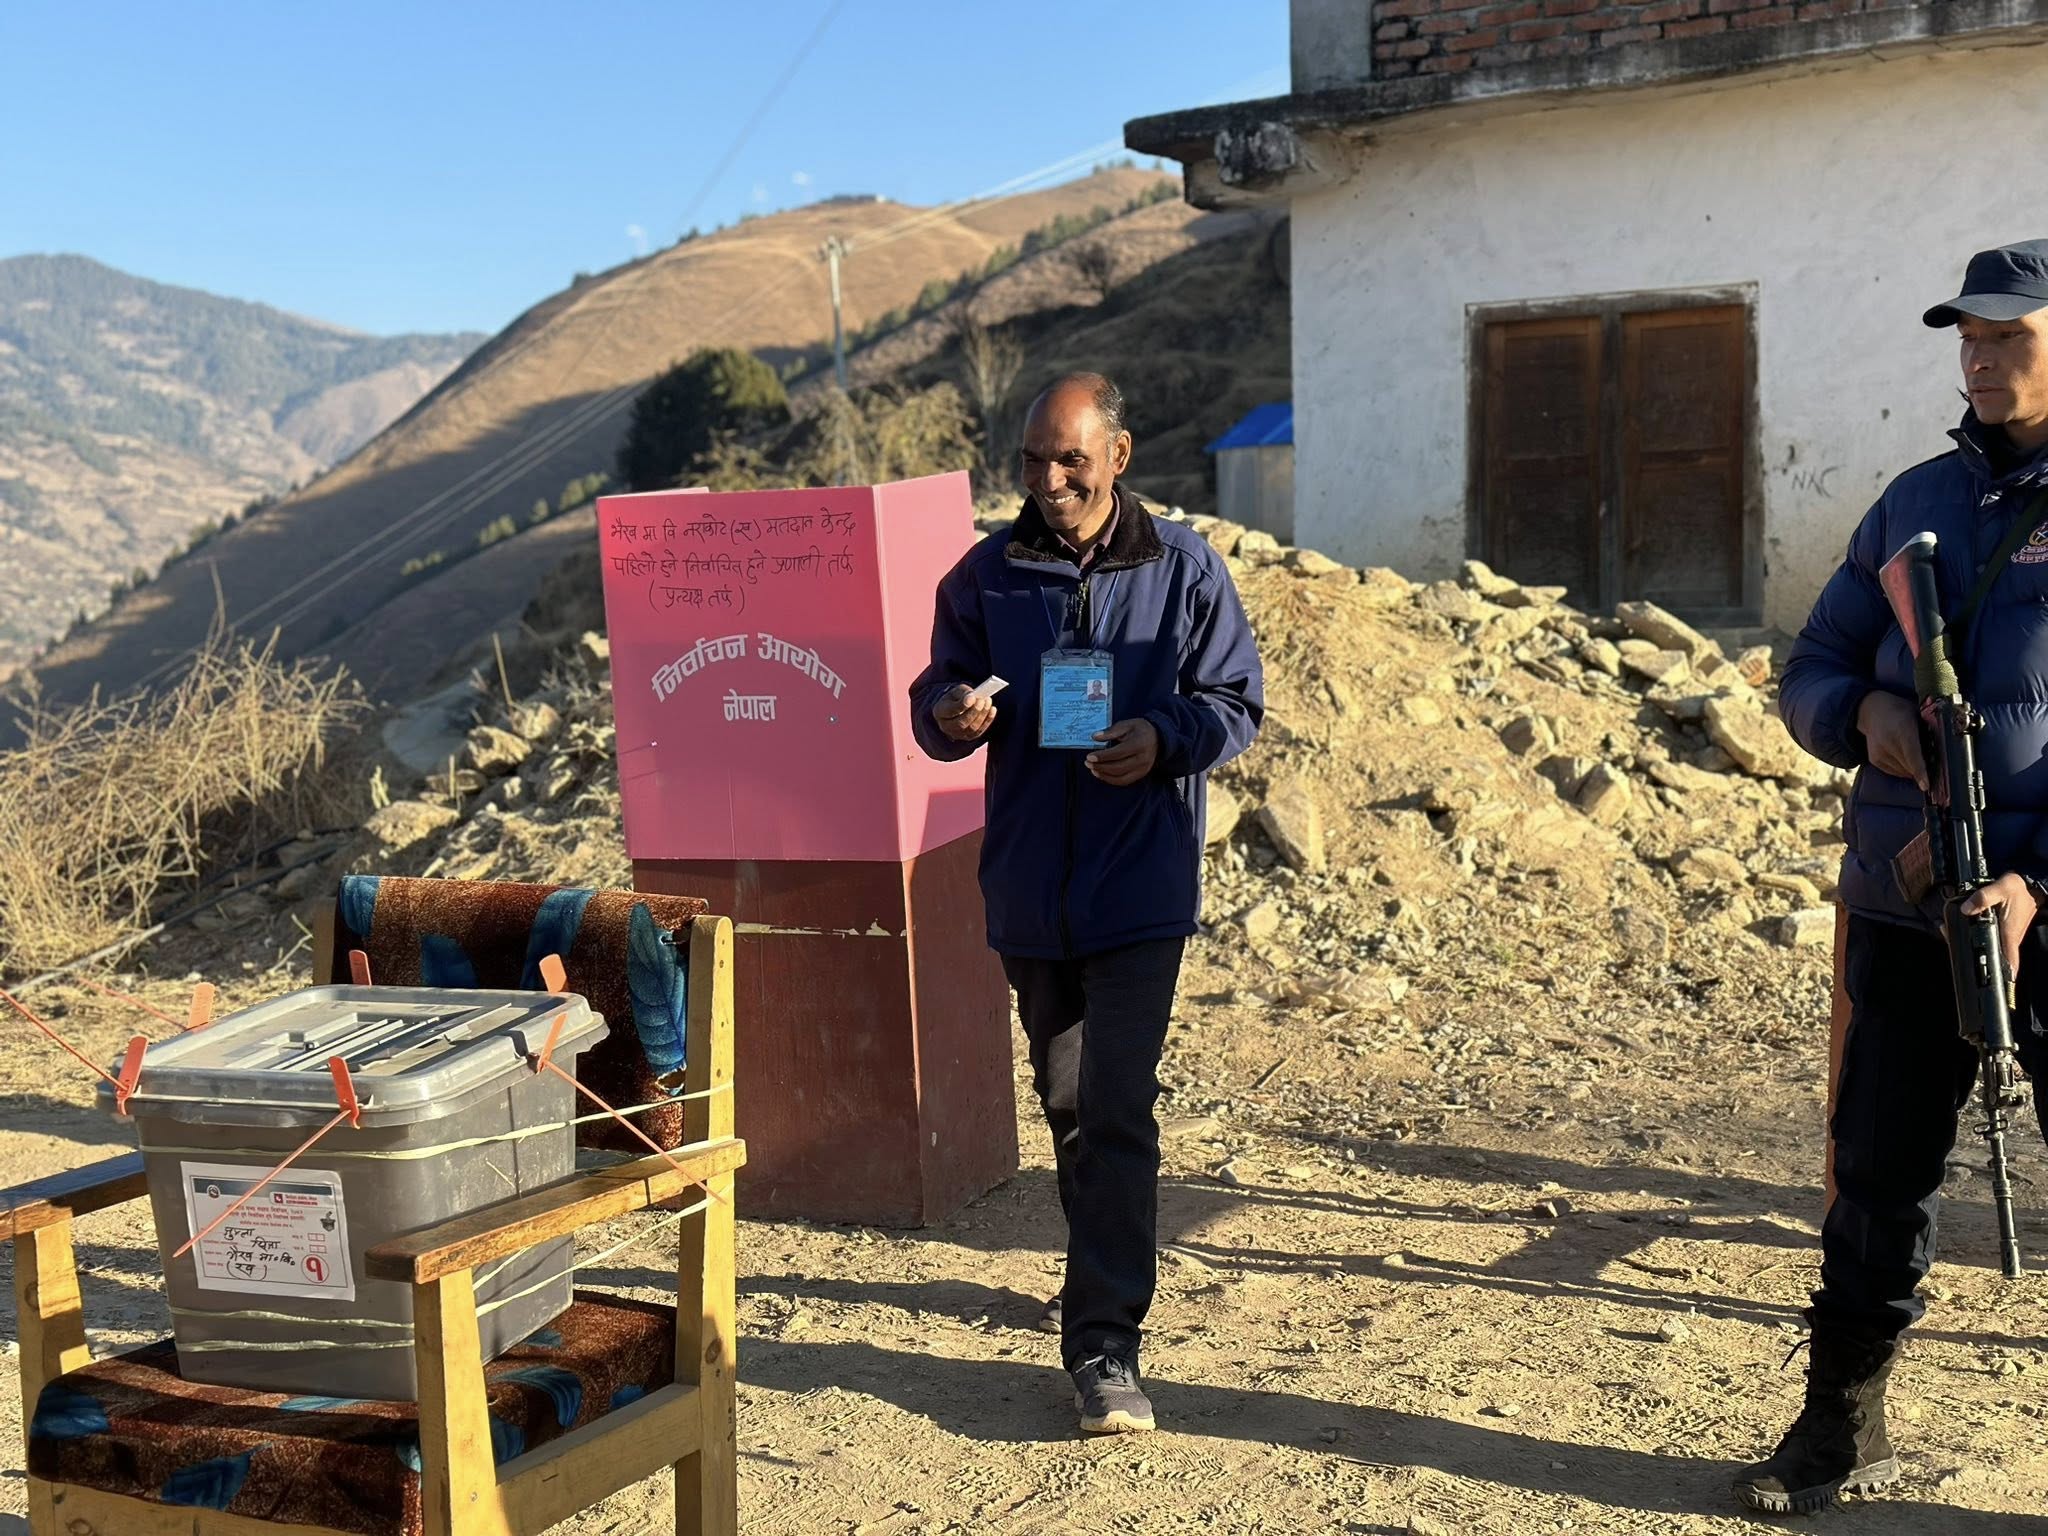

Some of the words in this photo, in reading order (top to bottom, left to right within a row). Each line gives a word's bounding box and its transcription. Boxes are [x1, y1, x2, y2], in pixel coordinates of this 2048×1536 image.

[643, 526, 656, 541] मा
[663, 518, 677, 542] वि
[764, 515, 814, 538] मतदान
[821, 507, 856, 537] केन्द्र
[611, 551, 657, 577] पहिलो
[660, 549, 678, 579] हुने
[683, 551, 744, 579] निर्वाचित
[747, 550, 767, 585] हुने
[771, 545, 825, 578] प्रणाली
[828, 545, 854, 577] तर्फ
[651, 634, 748, 703] निर्वाचन
[757, 632, 847, 700] आयोग
[723, 689, 777, 722] नेपाल
[305, 1257, 323, 1281] १
